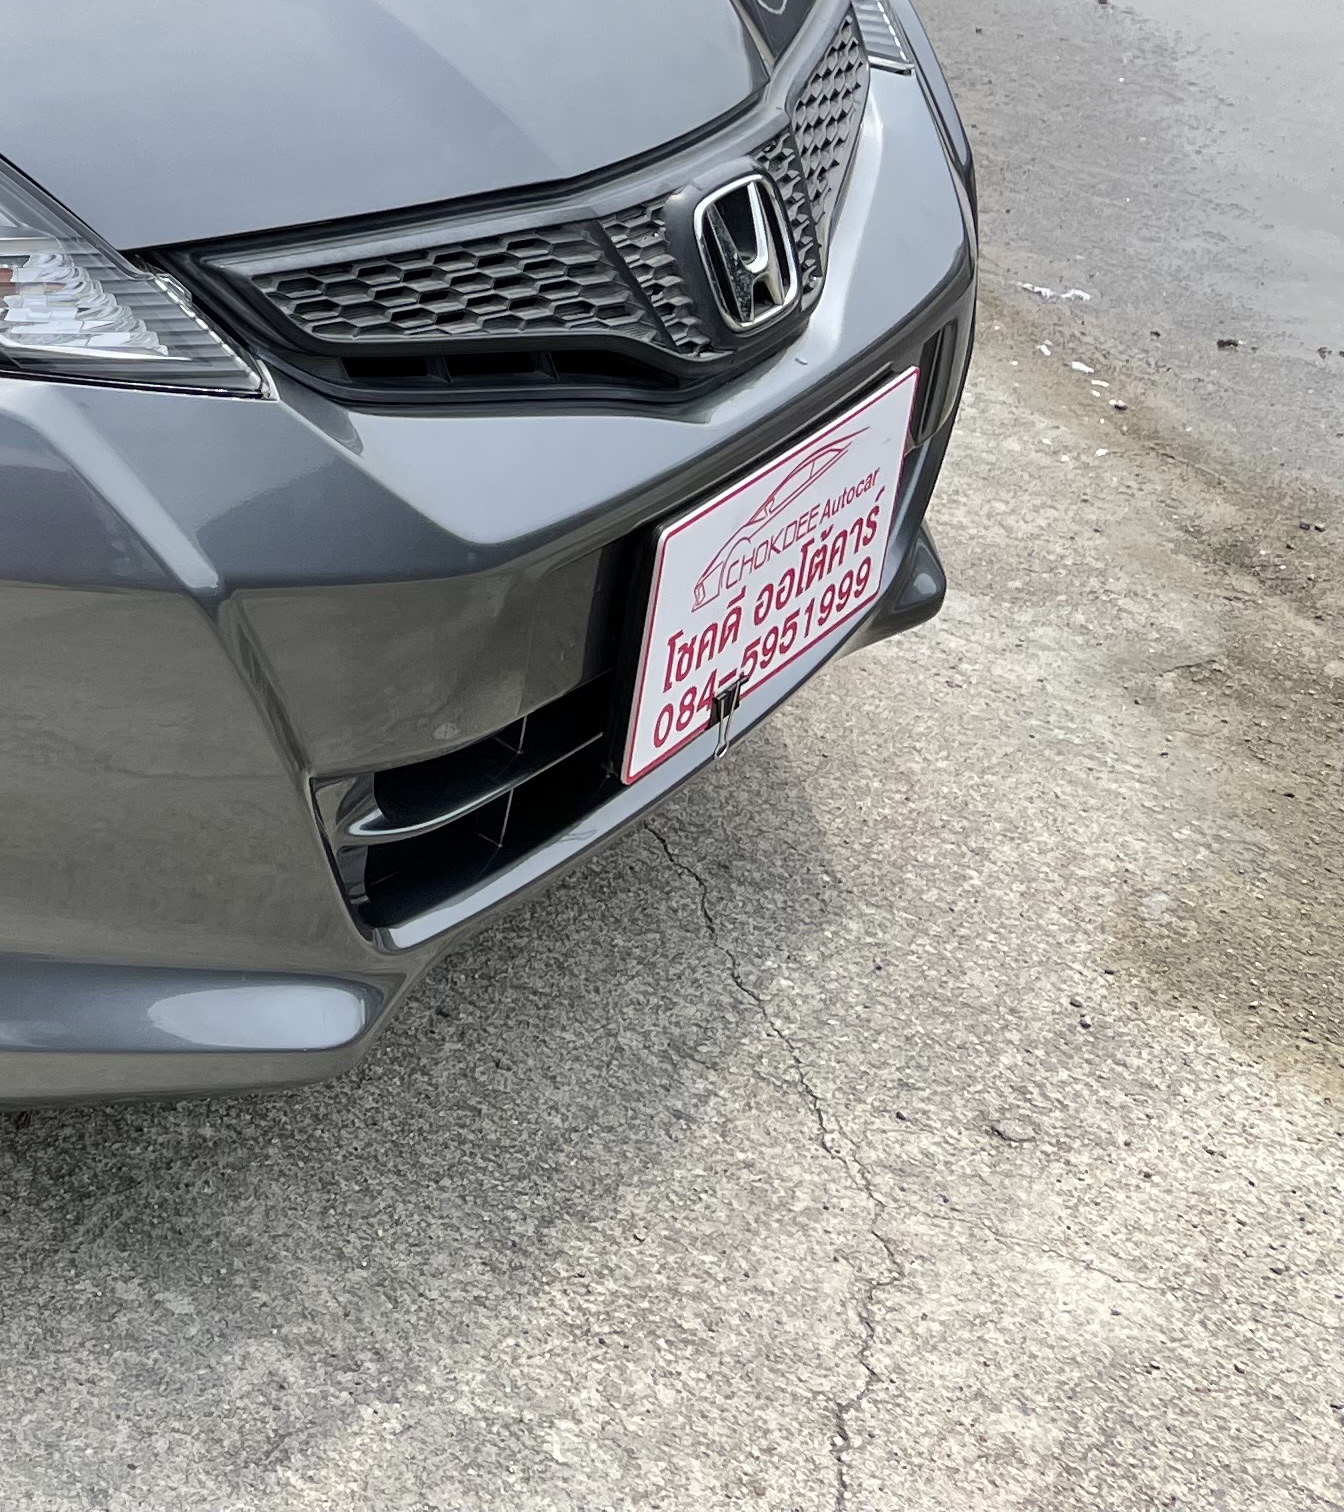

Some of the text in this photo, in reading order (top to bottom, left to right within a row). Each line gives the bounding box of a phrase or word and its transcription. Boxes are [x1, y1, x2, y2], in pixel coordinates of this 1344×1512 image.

[663, 485, 886, 694] โชคดี ออโต้คาร์
[725, 467, 881, 589] CHOKDEE Autocar
[653, 555, 872, 749] 084-5951999
